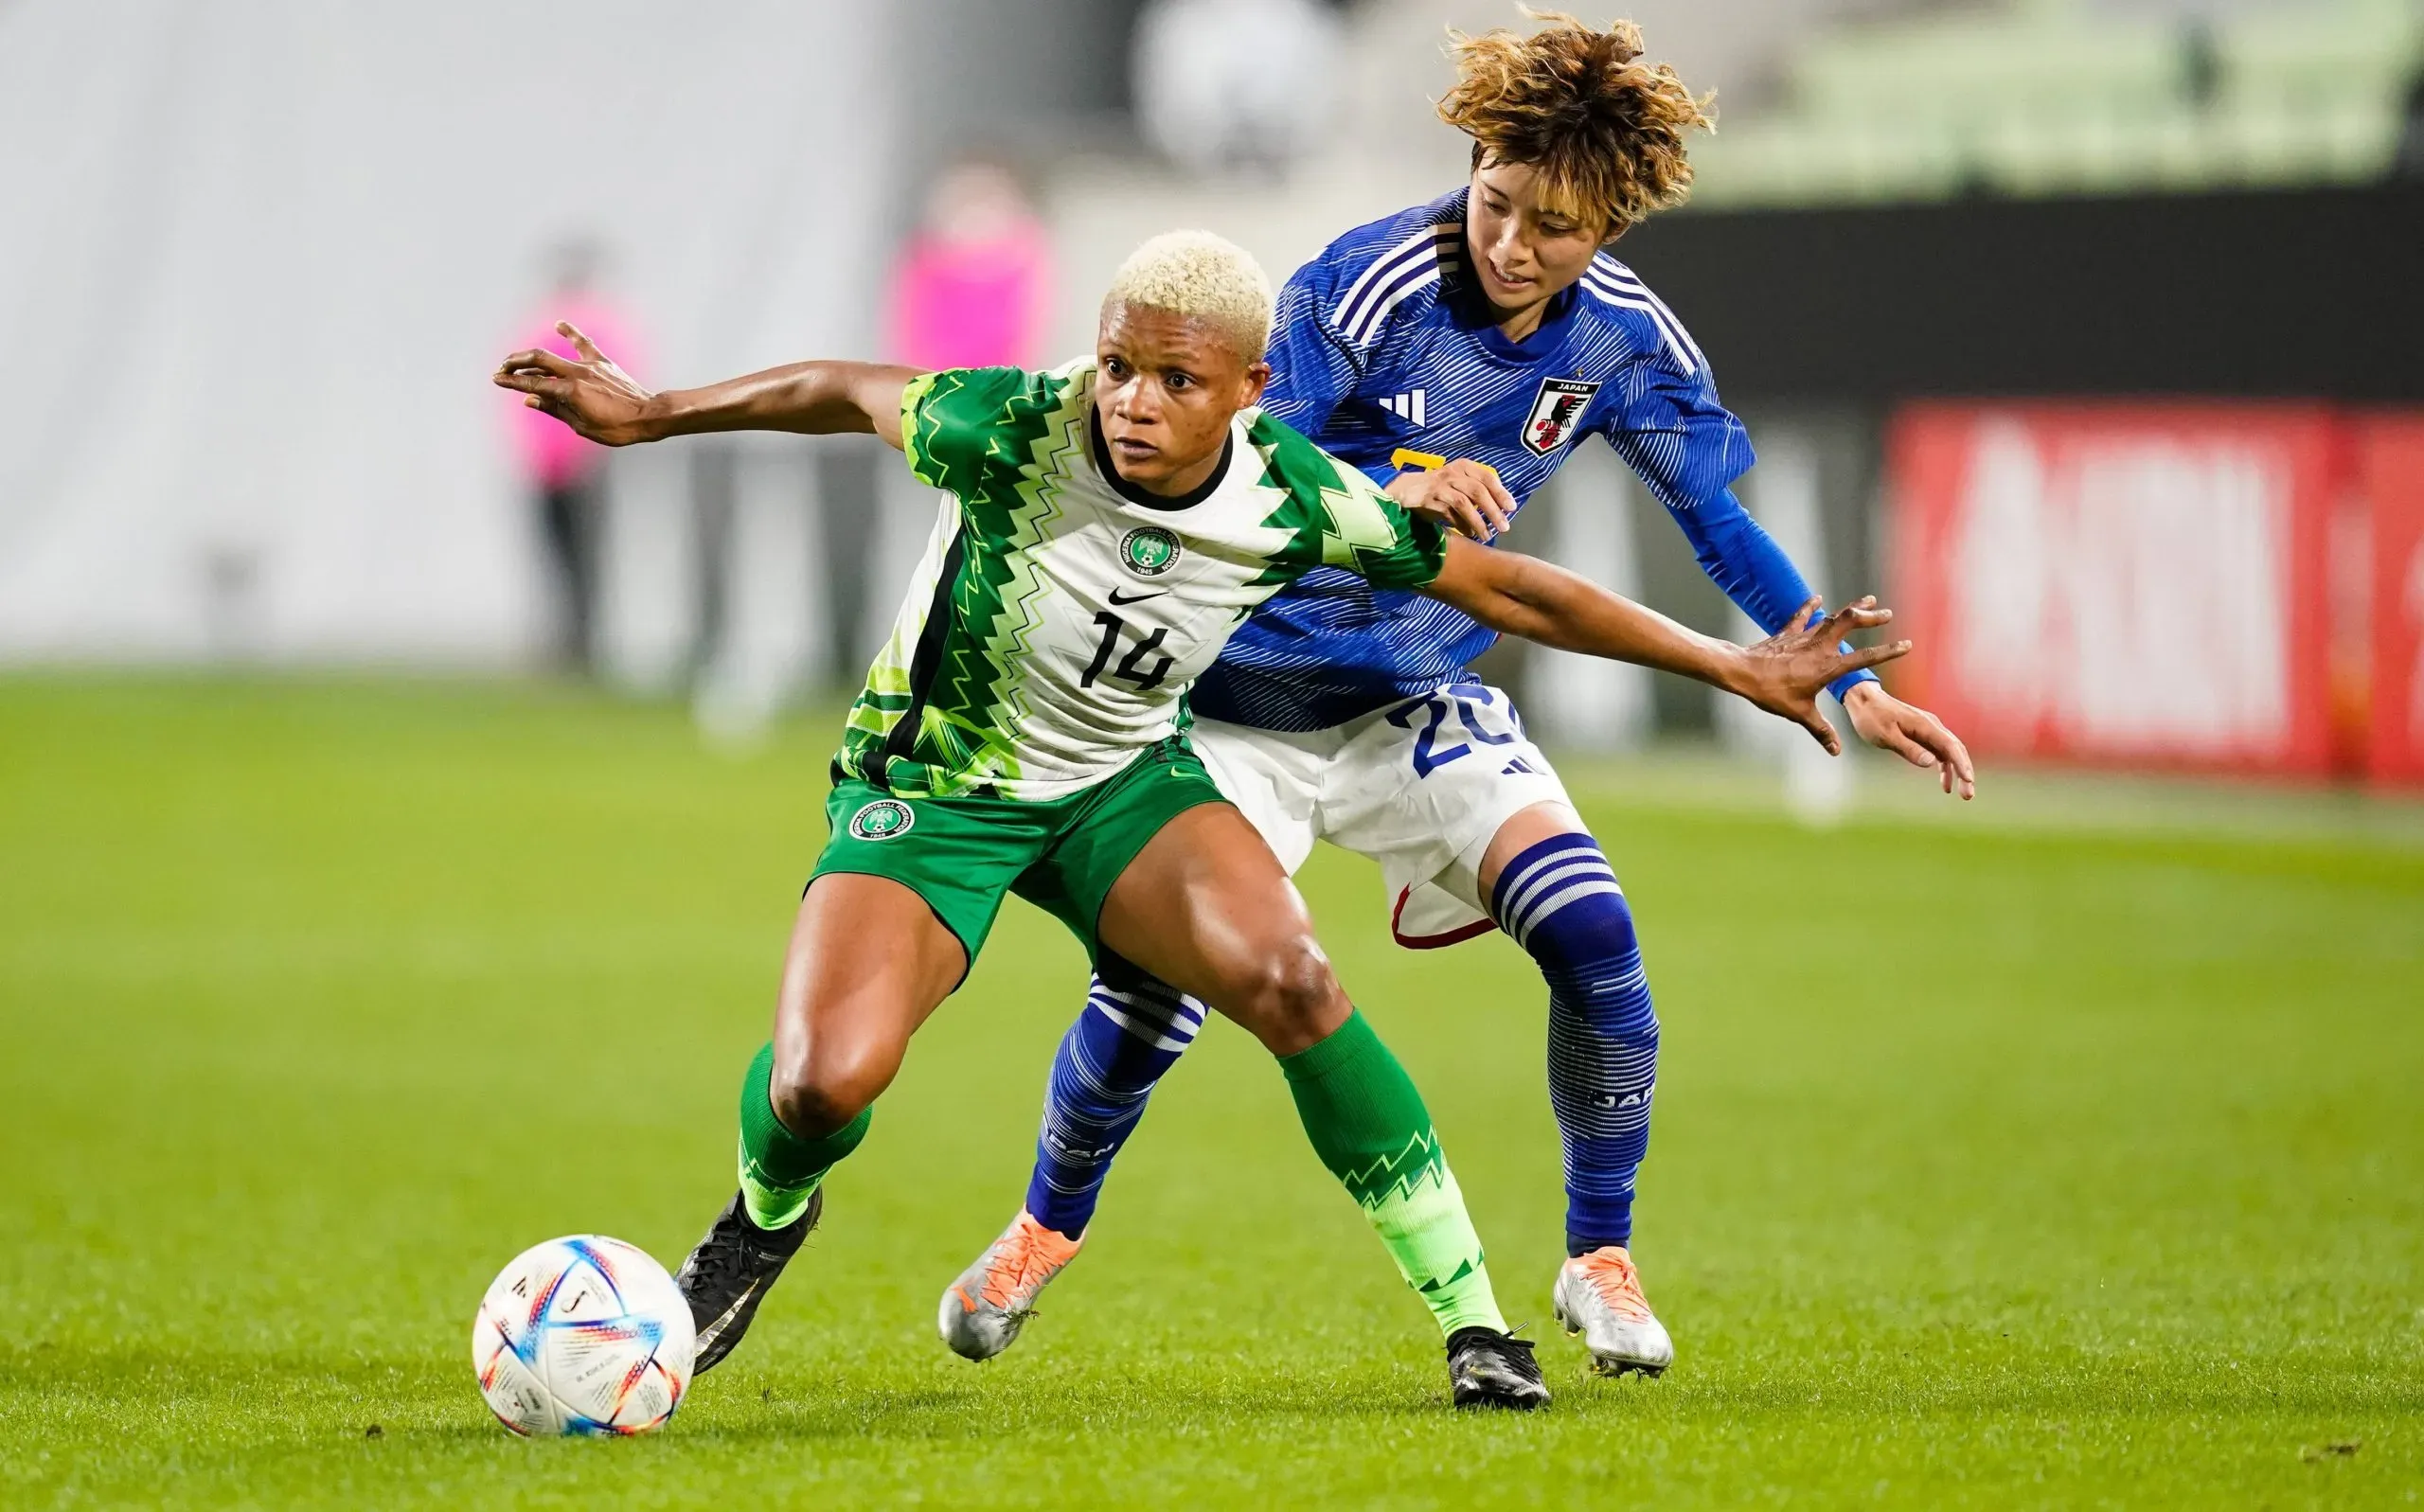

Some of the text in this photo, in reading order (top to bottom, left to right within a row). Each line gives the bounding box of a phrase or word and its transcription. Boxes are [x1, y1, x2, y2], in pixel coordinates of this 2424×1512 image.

[1557, 382, 1589, 392] JAPAN
[1121, 537, 1133, 563] NIGERIA
[1130, 527, 1167, 539] FOOTBALL
[1136, 566, 1153, 576] 1945
[1080, 611, 1176, 691] 14
[1384, 684, 1527, 780] 20
[860, 803, 895, 818] FOOTBALL
